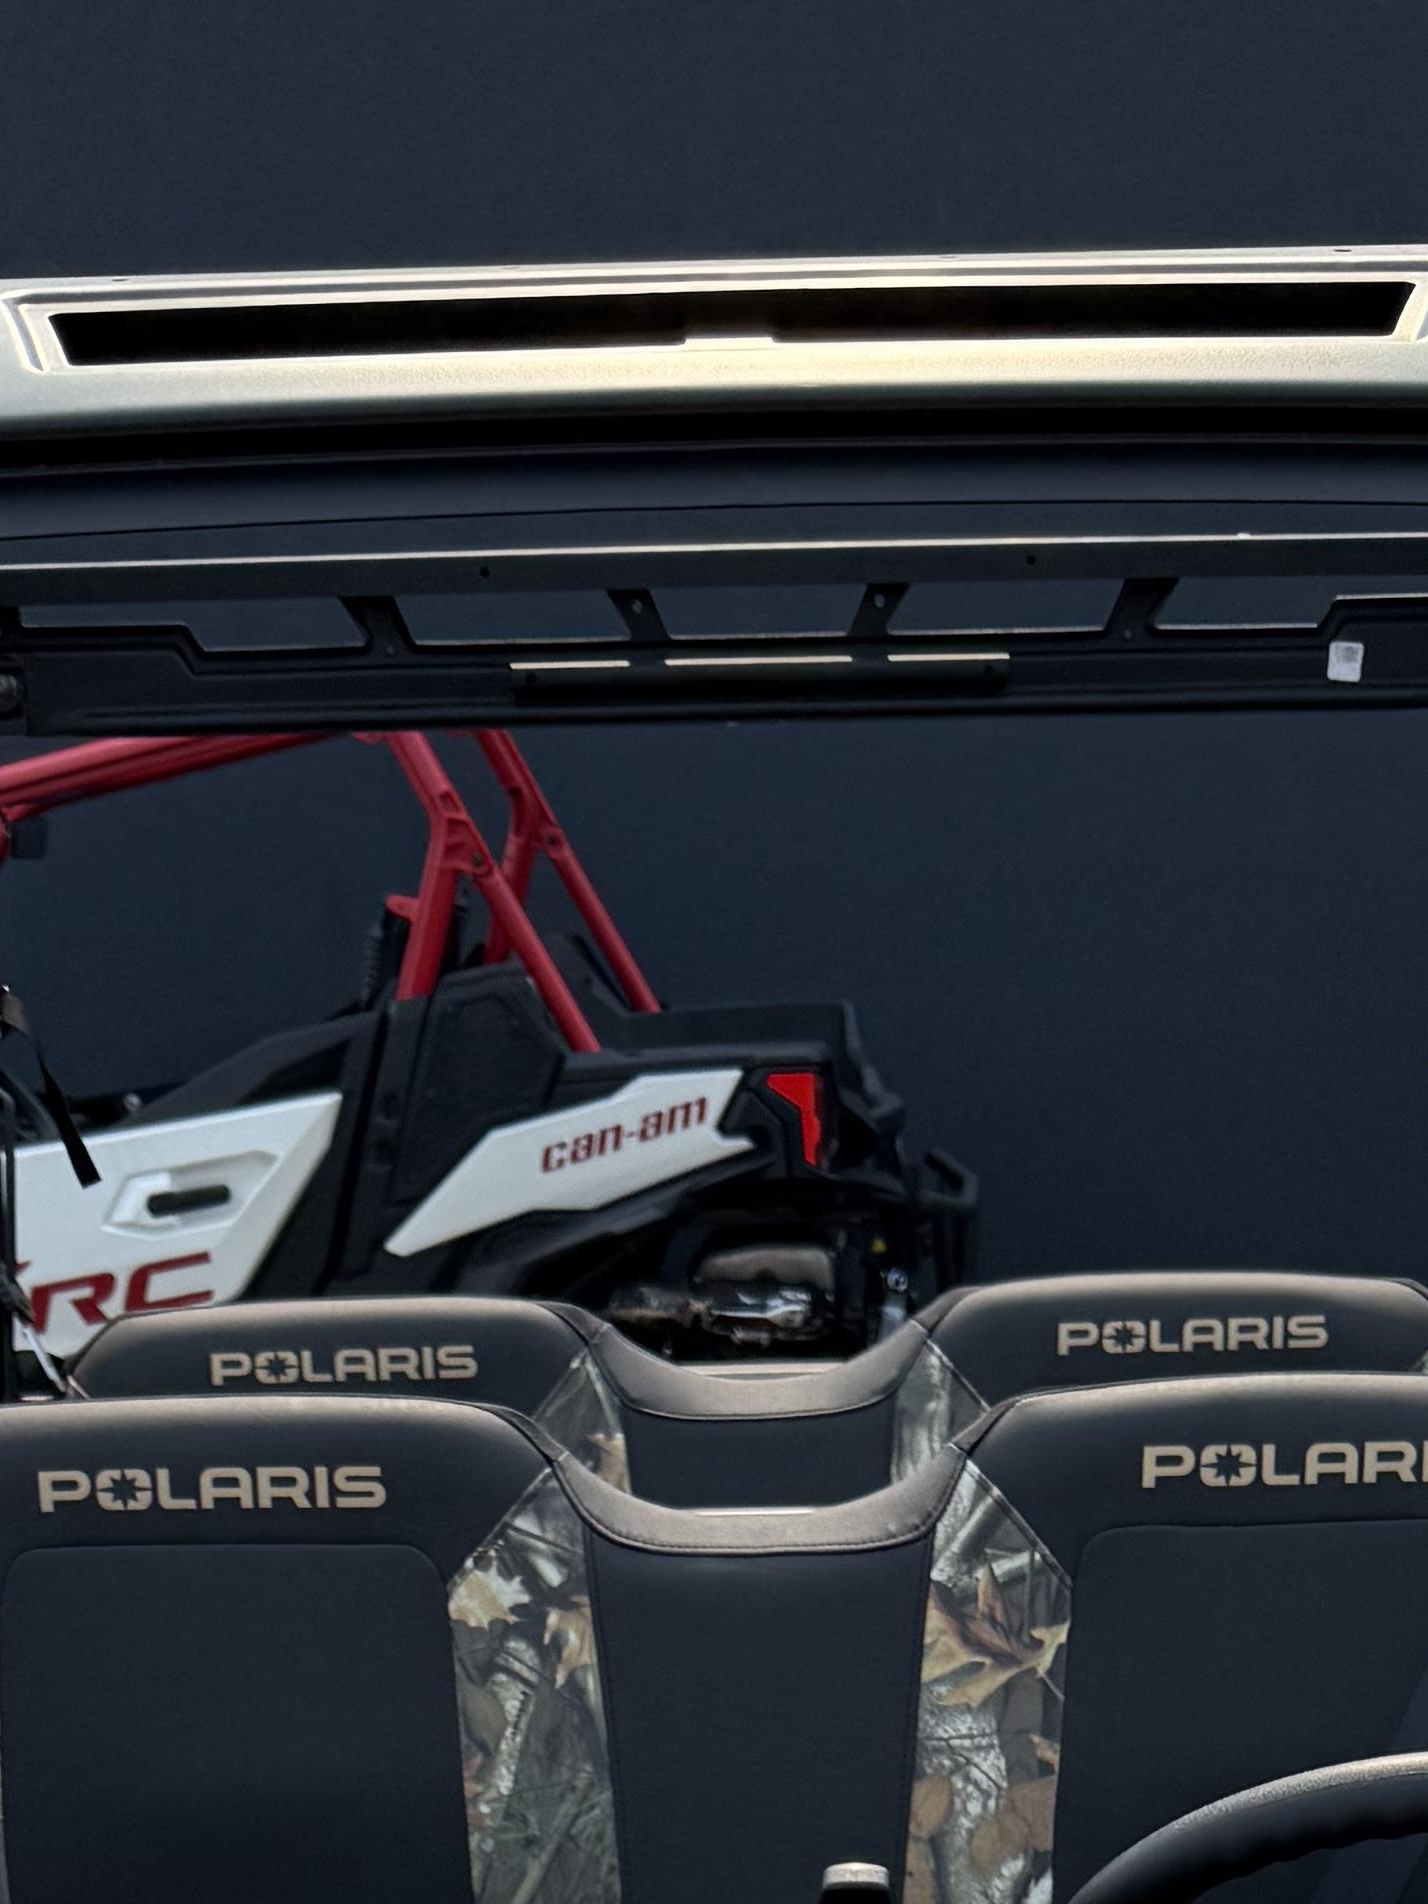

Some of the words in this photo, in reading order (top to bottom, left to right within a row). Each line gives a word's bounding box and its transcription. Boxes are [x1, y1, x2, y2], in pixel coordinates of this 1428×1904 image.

[541, 1096, 707, 1173] can-am
[1056, 1314, 1329, 1357] POLARIS
[210, 1345, 479, 1387] POLARIS
[37, 1465, 387, 1513] POLARIS
